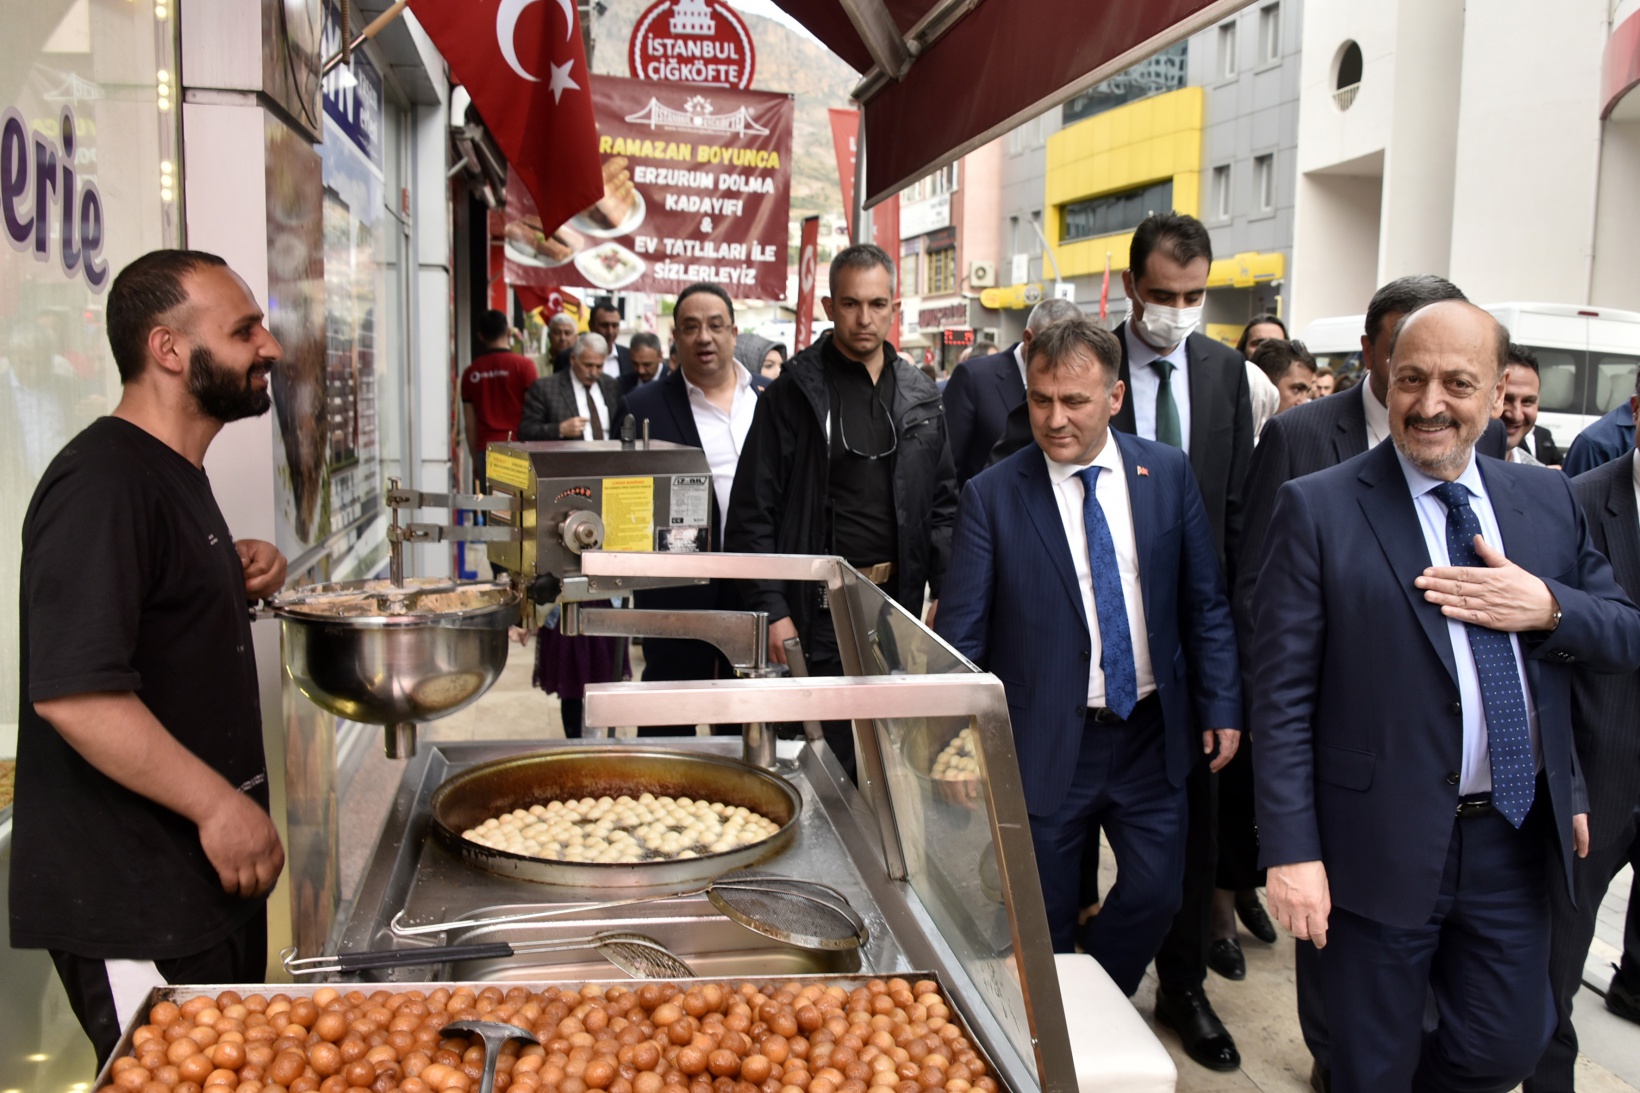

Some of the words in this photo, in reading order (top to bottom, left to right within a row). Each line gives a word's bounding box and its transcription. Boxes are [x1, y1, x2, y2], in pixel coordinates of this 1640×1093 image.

[647, 33, 739, 59] İSTANBUL
[647, 58, 739, 82] ÇİĞKÖFTE
[600, 136, 692, 161] RAMAZAN
[697, 145, 780, 169] BOYUNCA
[634, 166, 714, 190] ERZURUM
[718, 173, 775, 194] DOLMA
[0, 107, 108, 291] erie
[665, 194, 744, 217] KADAYIFI
[700, 216, 713, 233] &
[634, 236, 658, 253] EV
[663, 237, 747, 261] TATLILARI
[750, 240, 776, 261] İLE
[654, 258, 756, 285] SİZLERLEYİZ
